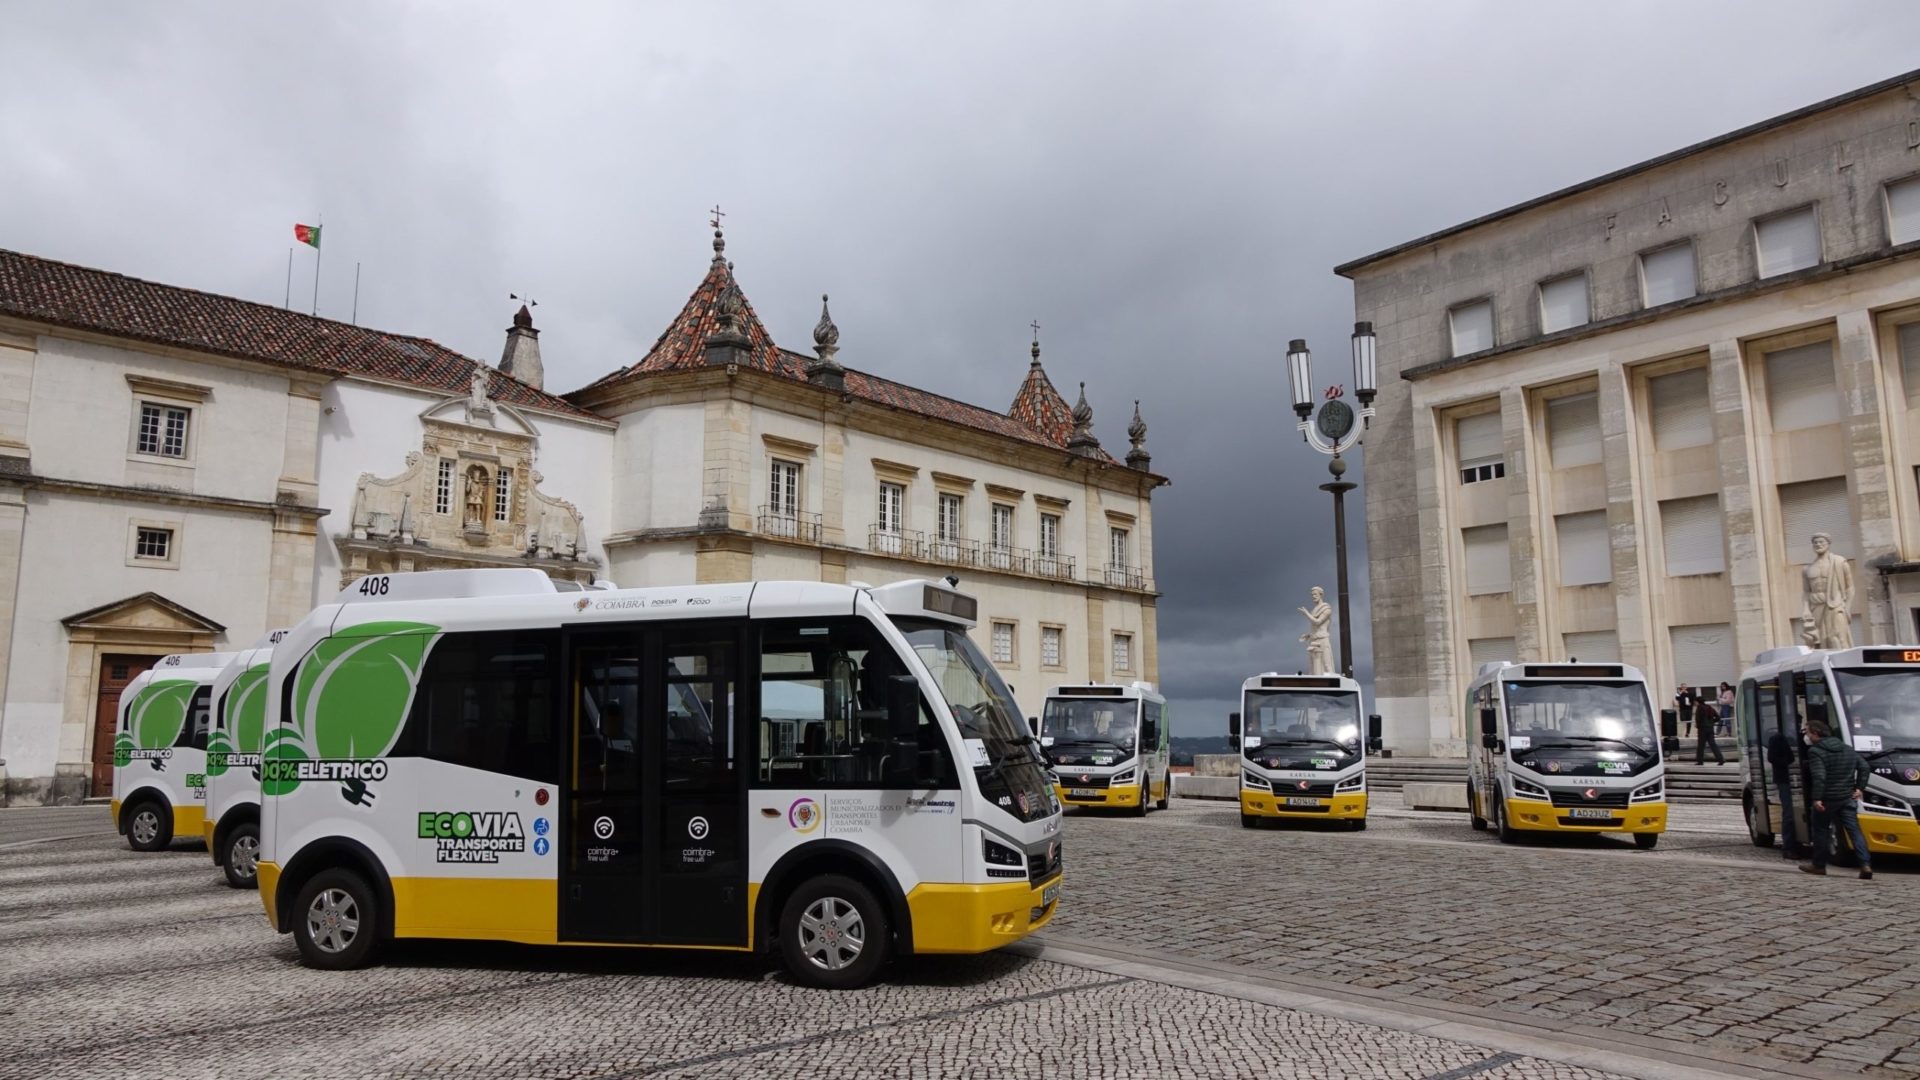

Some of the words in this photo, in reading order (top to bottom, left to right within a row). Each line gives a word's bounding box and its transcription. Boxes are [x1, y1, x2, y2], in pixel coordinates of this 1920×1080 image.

[359, 576, 390, 596] 408
[165, 656, 181, 666] 406
[1597, 761, 1630, 769] ECOVIA
[418, 811, 525, 839] ECOVIA
[438, 838, 524, 851] TRANSPORTE
